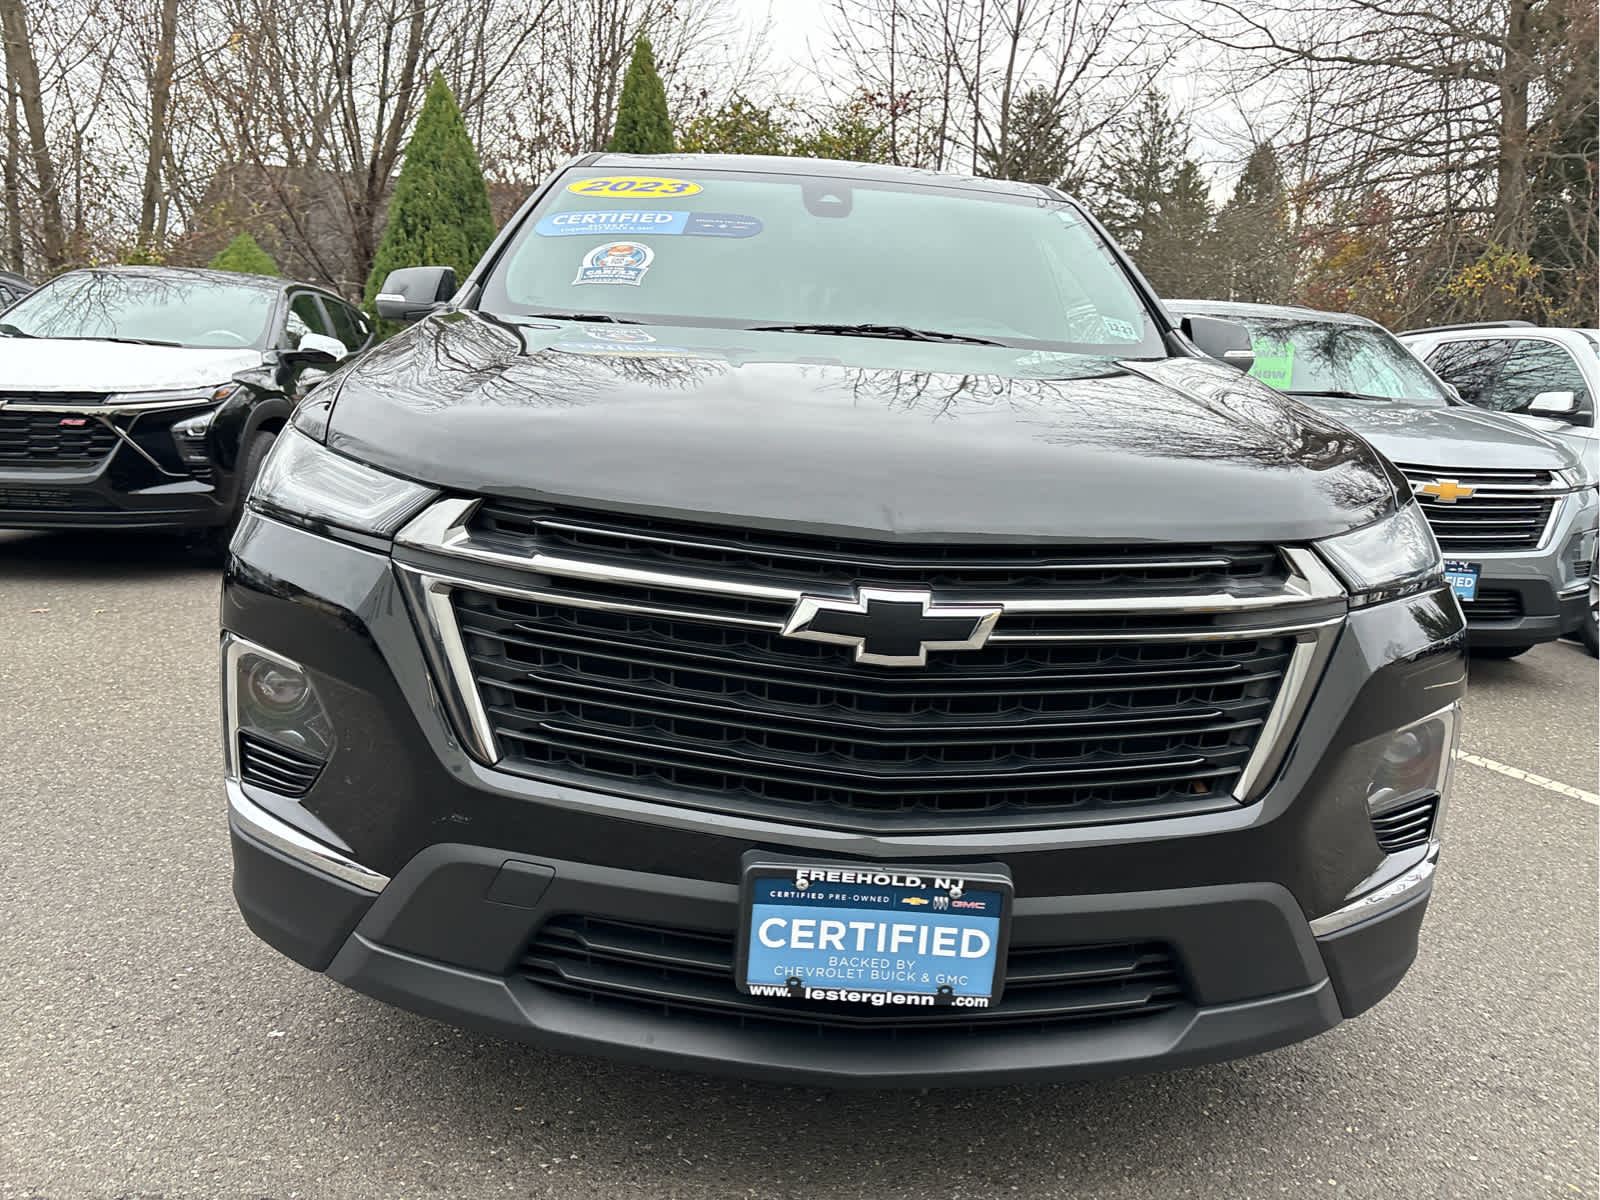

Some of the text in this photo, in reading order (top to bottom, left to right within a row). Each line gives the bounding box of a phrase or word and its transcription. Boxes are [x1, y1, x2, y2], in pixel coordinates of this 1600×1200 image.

[580, 181, 690, 194] 2023
[551, 213, 673, 225] CERTIFIED
[1253, 370, 1287, 379] NOW
[796, 869, 964, 889] FREEHOLD, NJ
[769, 890, 987, 910] CERTIFIED PRE-OWNED GMC
[758, 917, 991, 959] CERTIFIED
[828, 956, 916, 970] BACKED BY
[773, 965, 969, 986] CHEVROLET BUICK & GMC
[750, 985, 791, 998] www.
